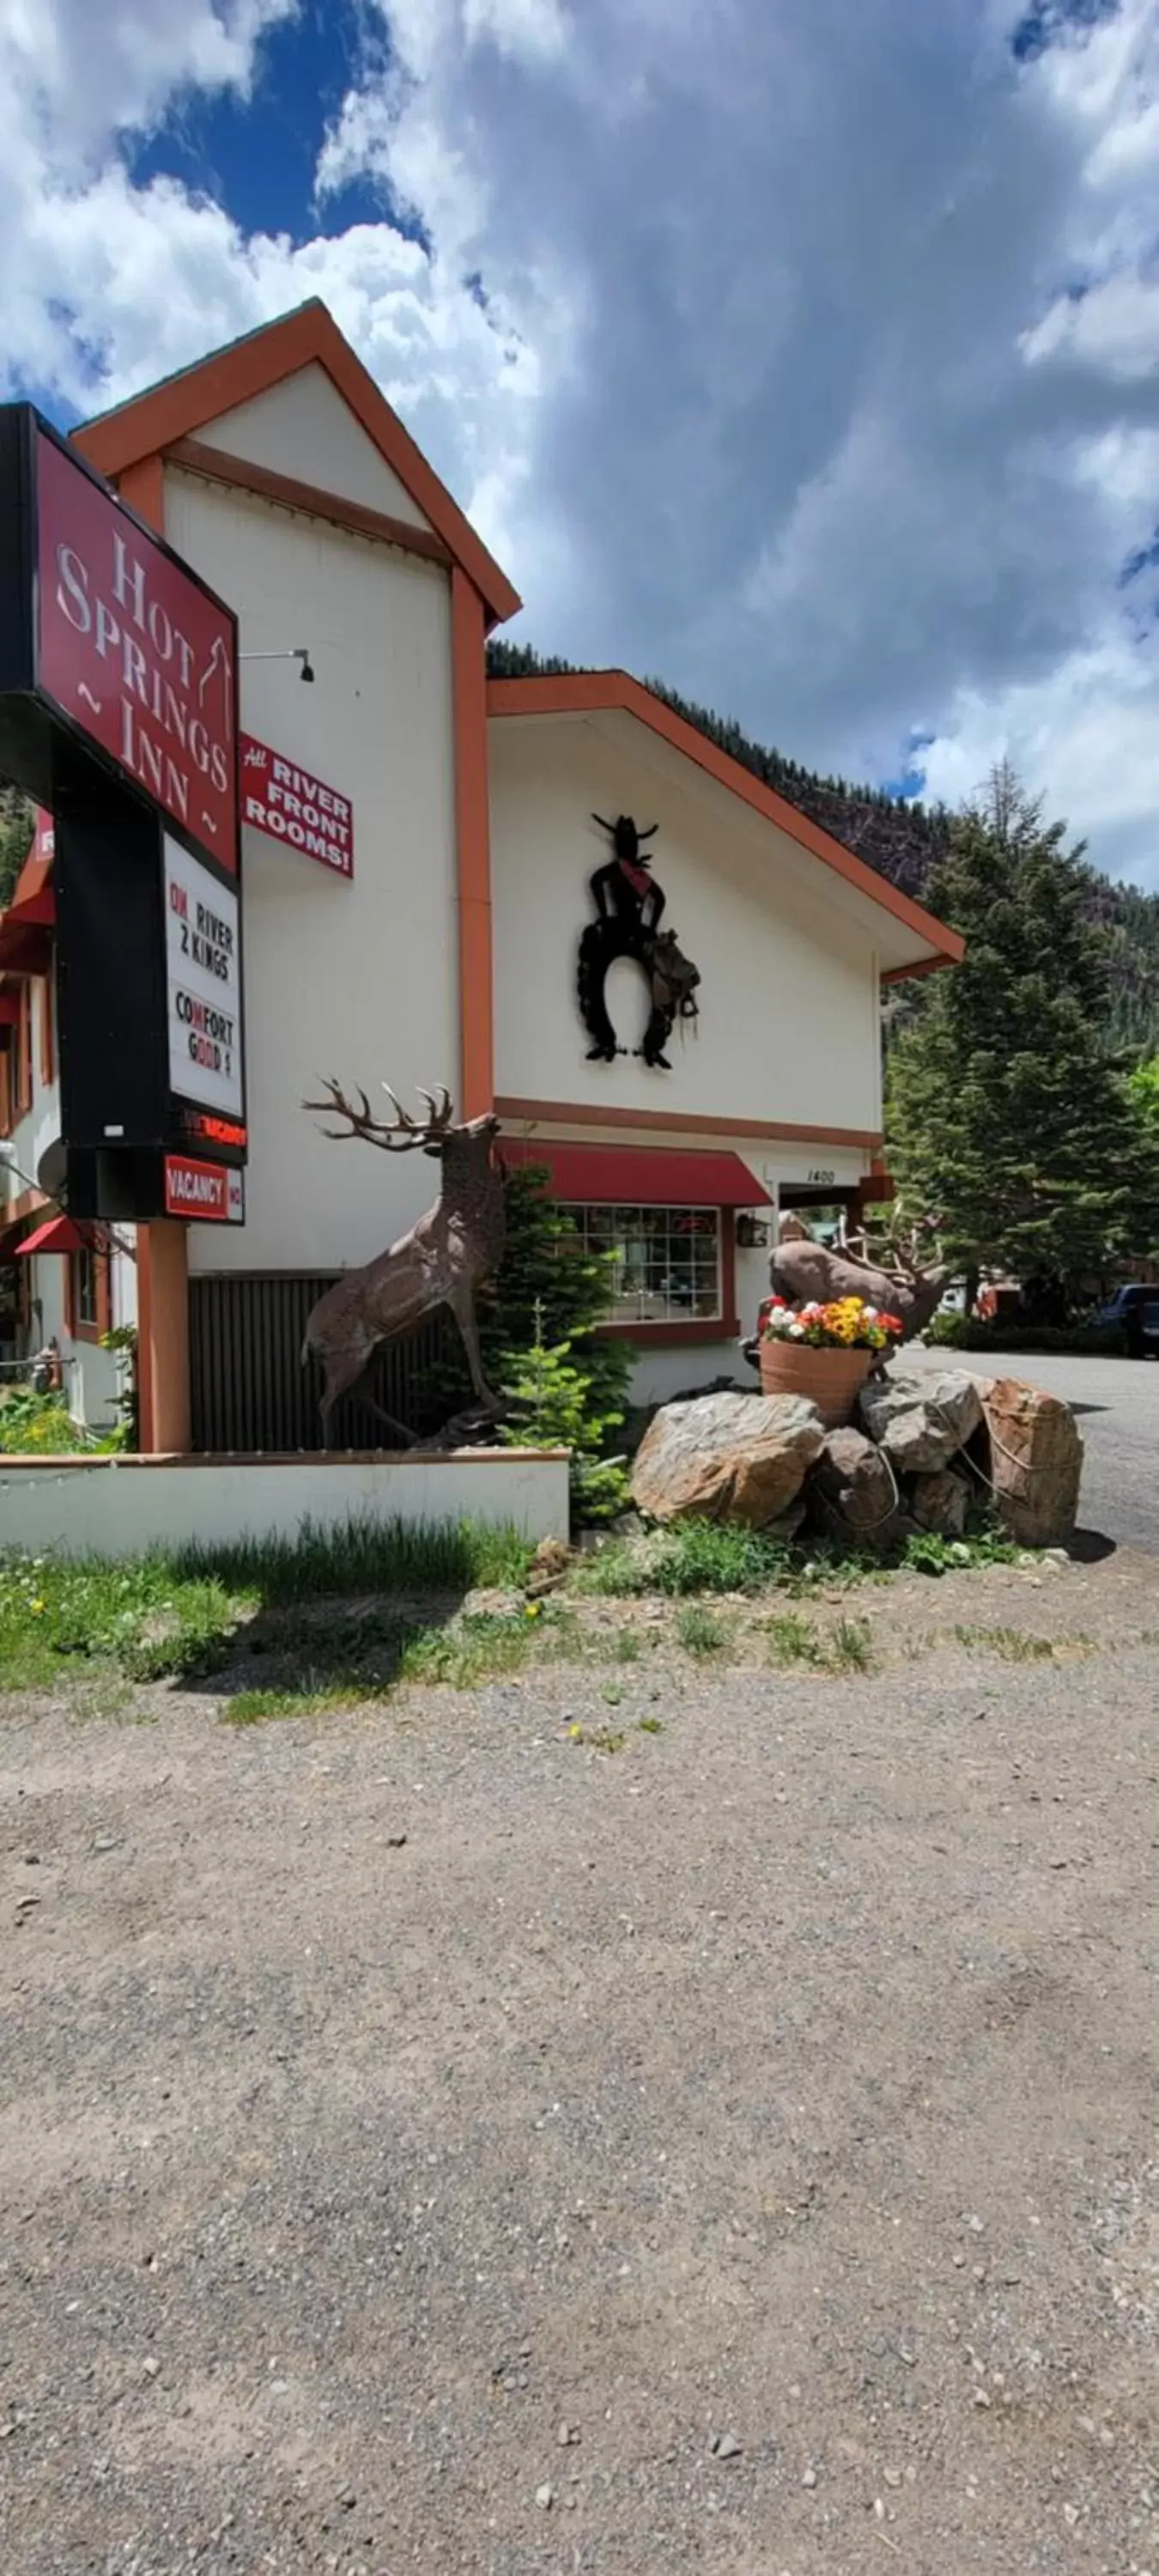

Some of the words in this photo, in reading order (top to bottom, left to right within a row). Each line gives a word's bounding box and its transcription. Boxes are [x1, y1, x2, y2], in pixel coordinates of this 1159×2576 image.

[112, 530, 195, 690] HOT
[56, 543, 229, 793] SPRINGS
[120, 695, 190, 821] INN
[267, 780, 349, 845] FRONT
[272, 756, 349, 823] RIVER
[246, 796, 350, 872] ROOMS!
[180, 923, 190, 955] 2
[191, 931, 228, 982] KINGS
[197, 902, 234, 955] RIVER
[176, 990, 234, 1047] COMFORT
[188, 1032, 222, 1072] GOOD
[167, 1166, 223, 1206] VACANCY
[807, 1169, 835, 1183] 1400
